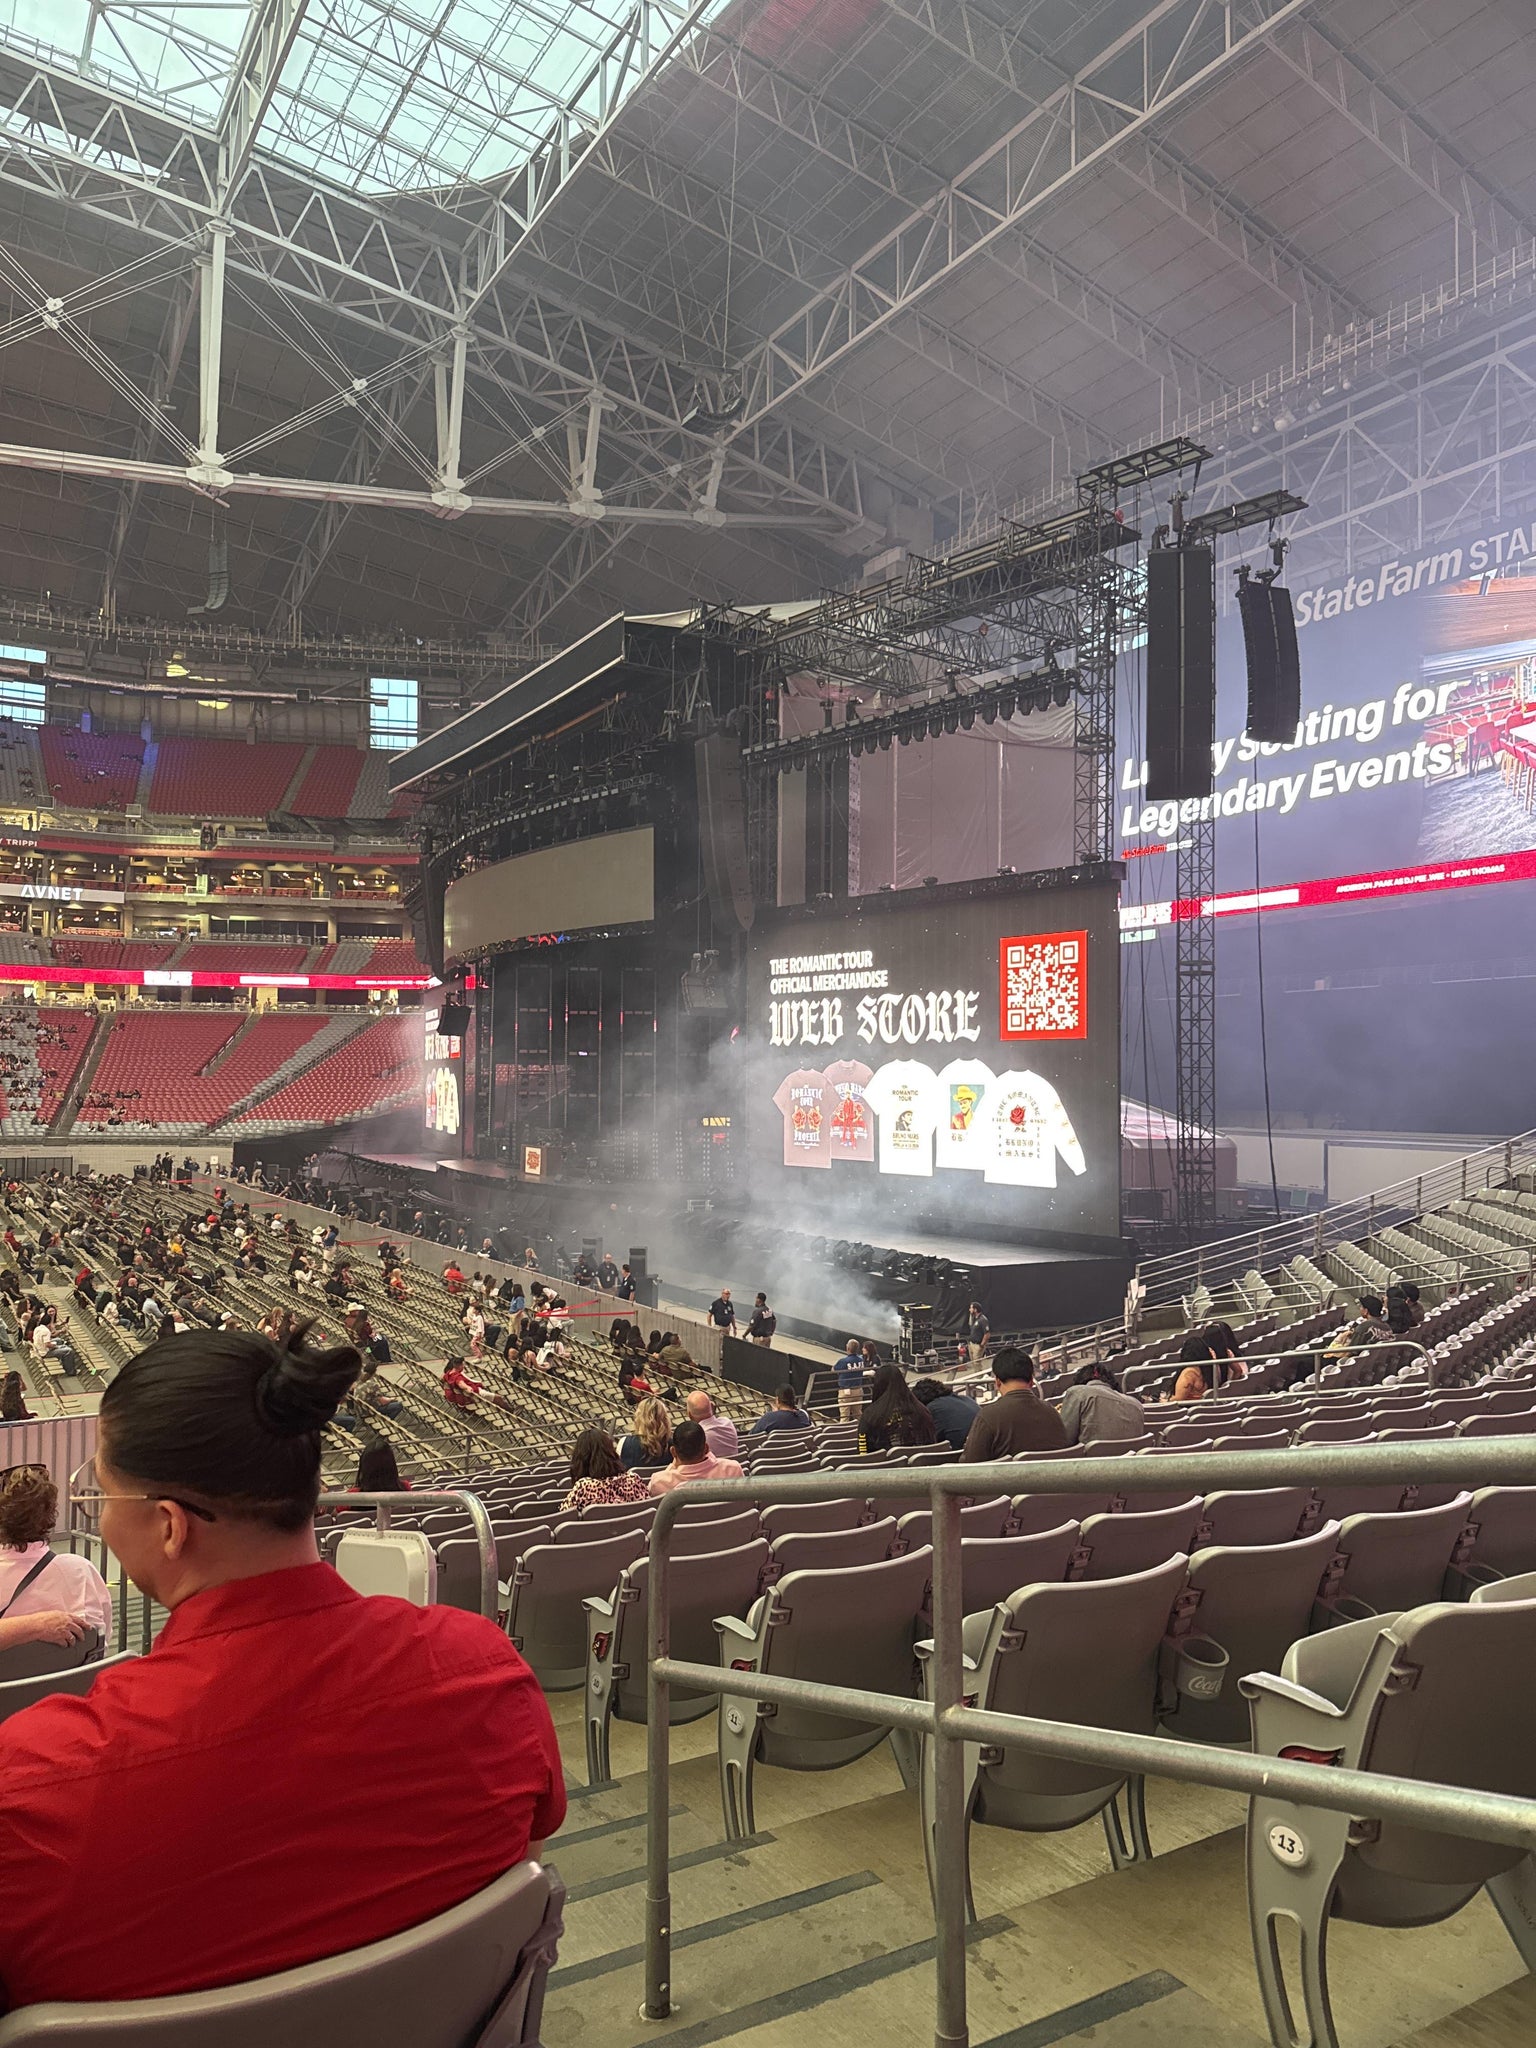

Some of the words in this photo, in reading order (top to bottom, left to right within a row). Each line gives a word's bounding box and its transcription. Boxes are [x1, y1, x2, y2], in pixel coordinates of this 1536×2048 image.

[1469, 522, 1536, 571] STA
[1392, 681, 1457, 726] for
[1121, 773, 1306, 838] Legendary
[1309, 741, 1453, 798] Events
[6, 838, 37, 847] TRIPPI
[1451, 868, 1470, 878] LEON
[1471, 864, 1505, 876] THOMAS
[20, 884, 83, 901] AVNET
[769, 959, 789, 975] THE
[789, 953, 842, 974] ROMANTIC
[842, 950, 873, 969] TOUR
[769, 975, 812, 995] OFFICIAL
[812, 970, 889, 992] MERCHANDISE
[769, 997, 844, 1047] WEB
[855, 989, 981, 1045] STORE
[730, 1713, 738, 1726] 11
[1277, 1834, 1296, 1854] 13
